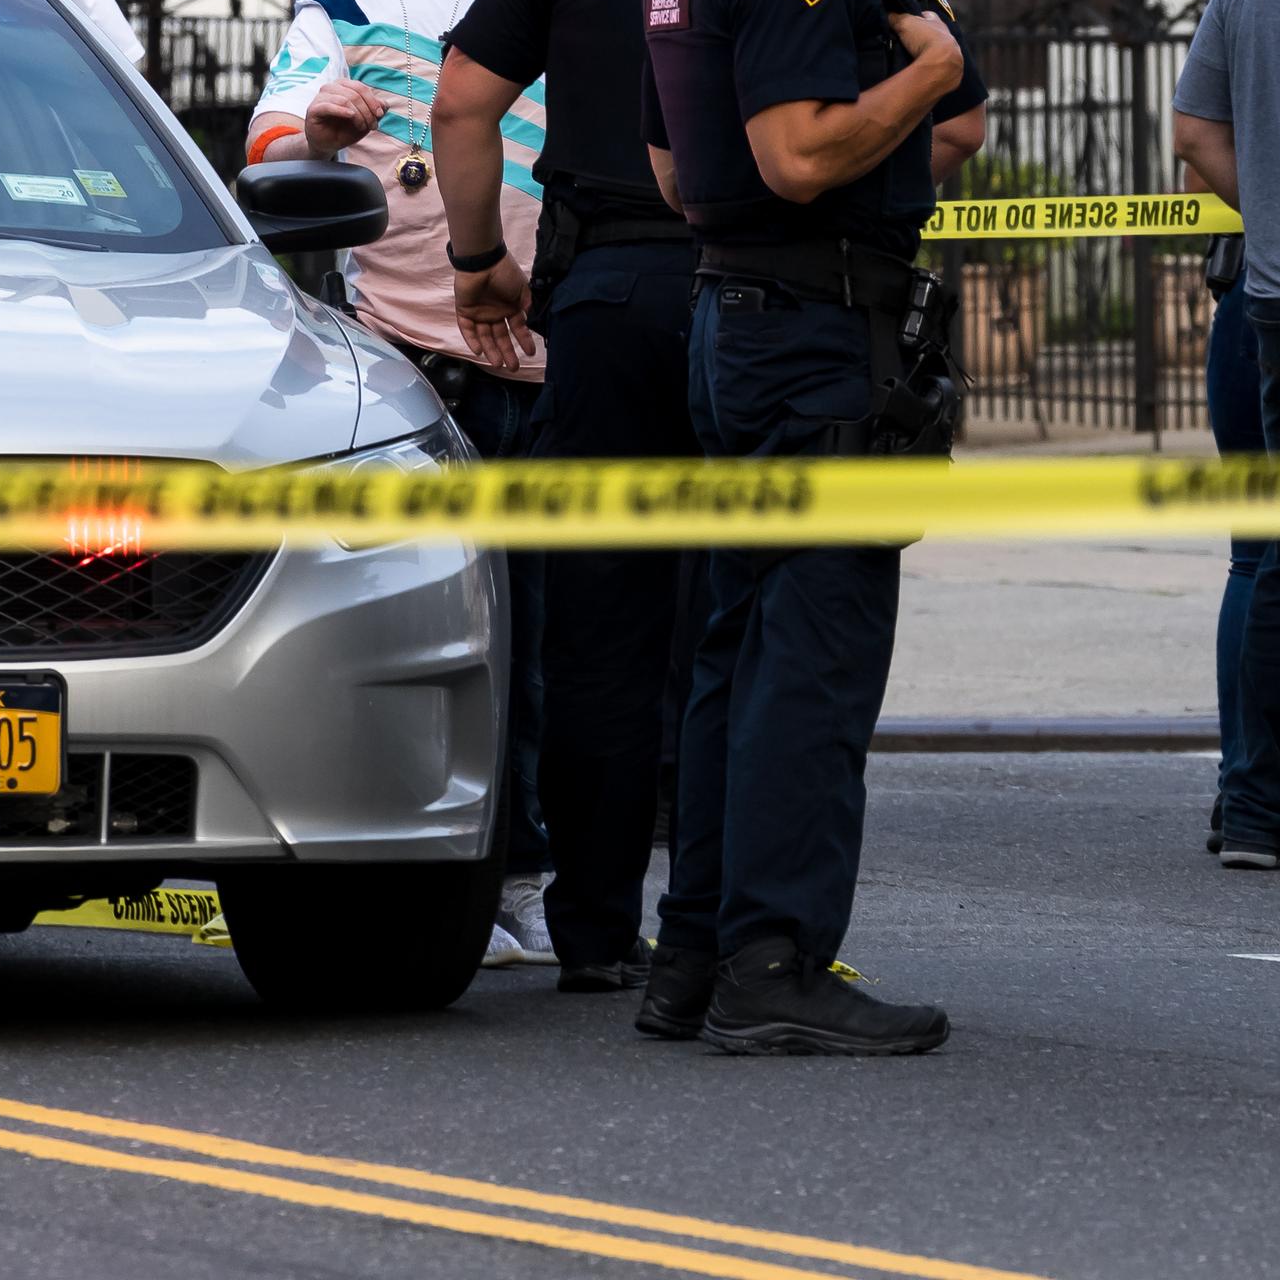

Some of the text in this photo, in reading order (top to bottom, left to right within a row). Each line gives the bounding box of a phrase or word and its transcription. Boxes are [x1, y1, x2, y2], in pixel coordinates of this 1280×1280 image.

[649, 9, 669, 26] SERVICE
[58, 188, 74, 198] 20
[113, 891, 217, 926] CRIME SCENE
